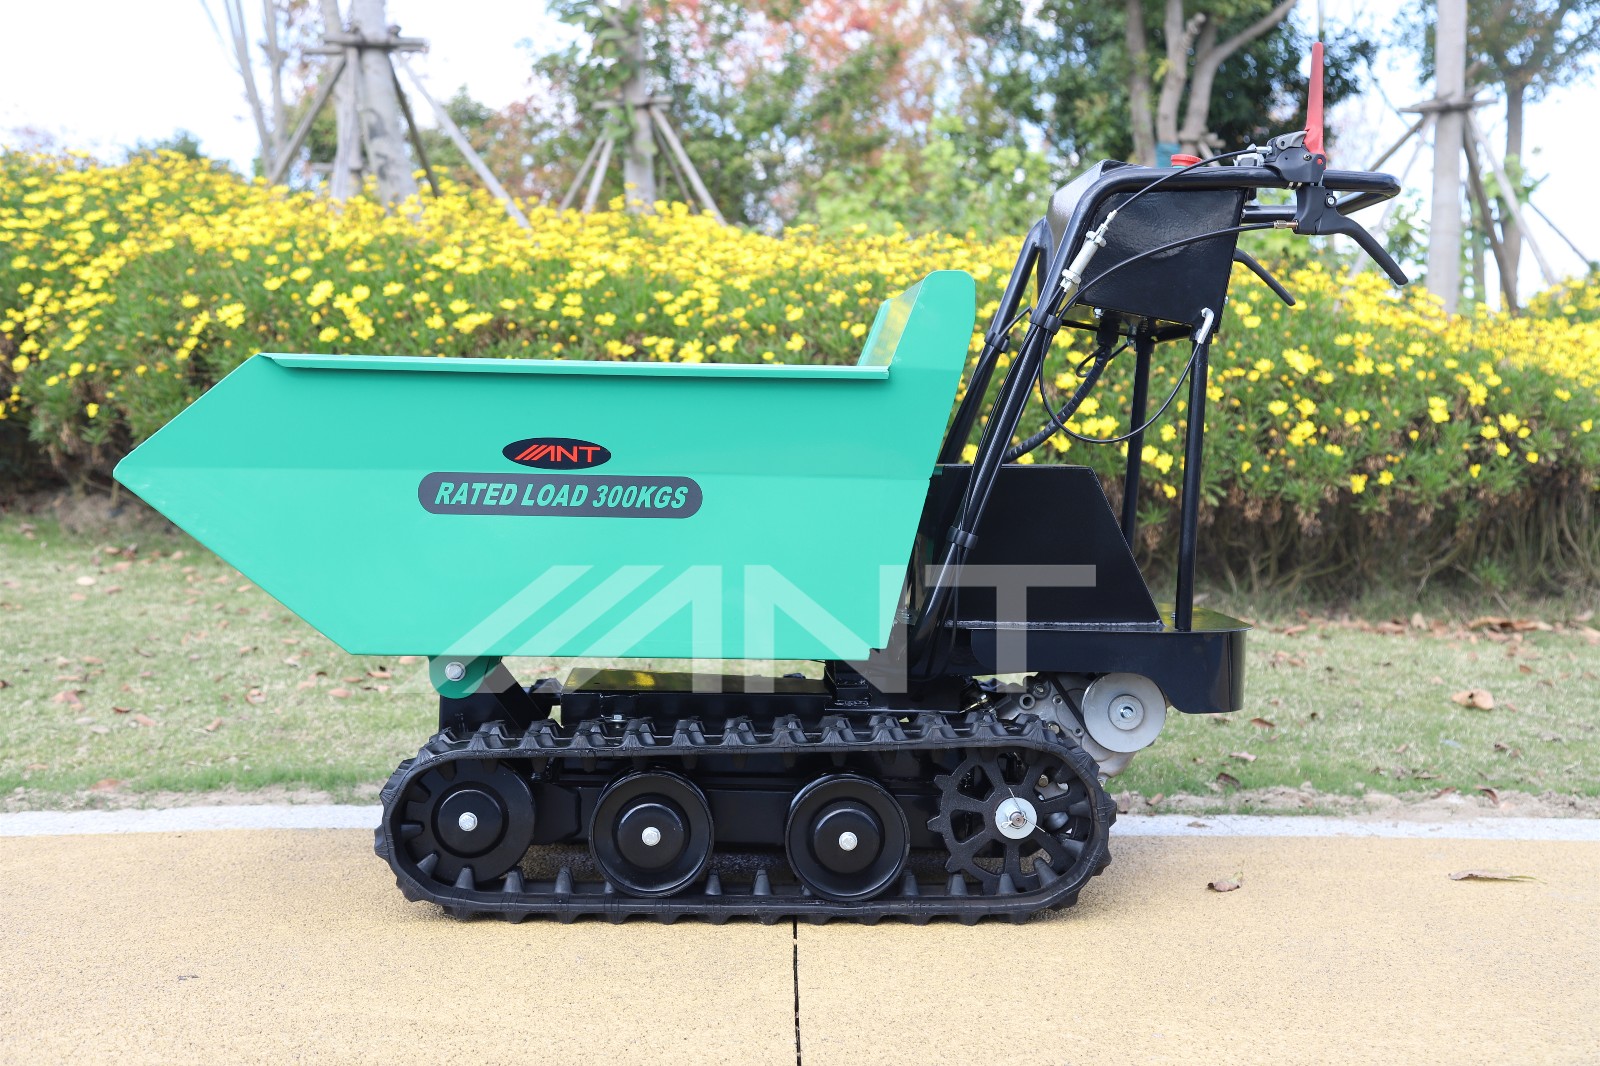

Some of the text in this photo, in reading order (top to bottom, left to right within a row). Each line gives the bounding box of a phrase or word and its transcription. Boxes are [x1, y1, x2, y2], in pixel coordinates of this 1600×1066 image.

[434, 481, 690, 509] RATED LOAD 300KGS
